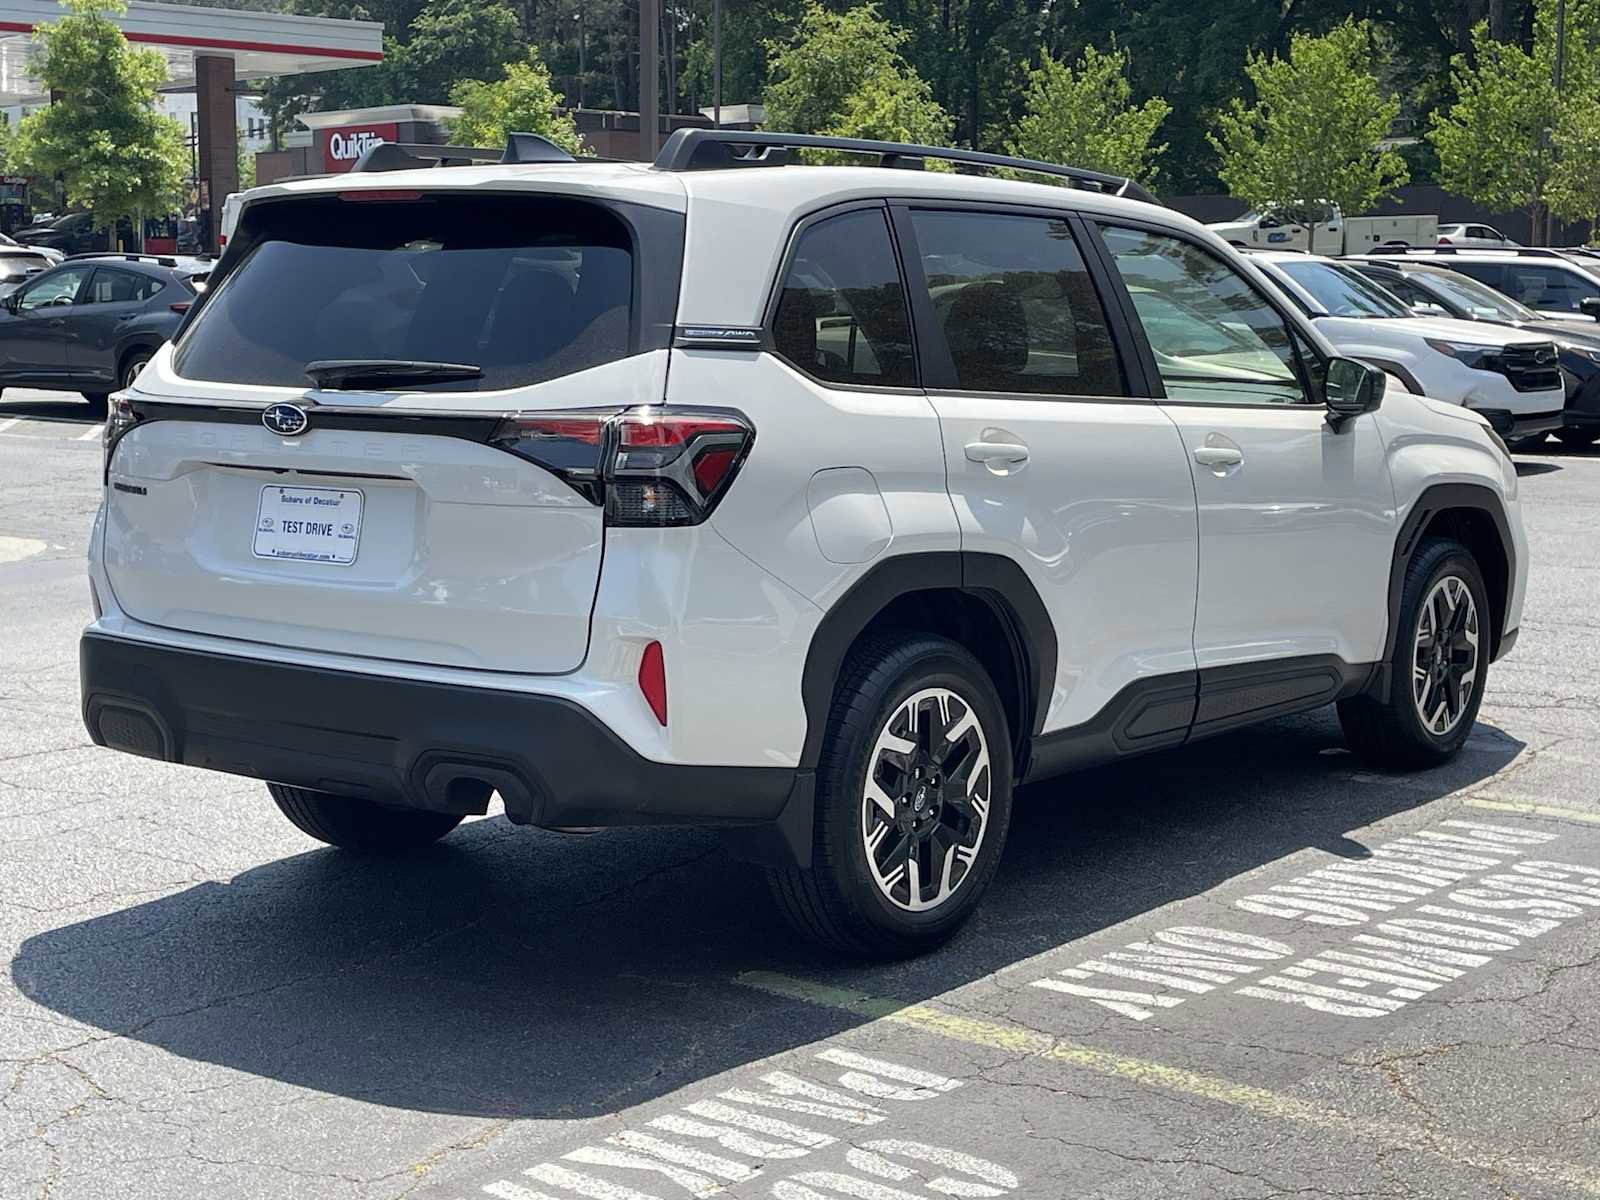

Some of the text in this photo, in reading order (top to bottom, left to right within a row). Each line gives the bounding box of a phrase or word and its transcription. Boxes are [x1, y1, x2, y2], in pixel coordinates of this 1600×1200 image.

[314, 497, 341, 506] Decatur
[282, 520, 333, 536] TEST DRIVE
[1030, 820, 1560, 1021] PARKING ONLY
